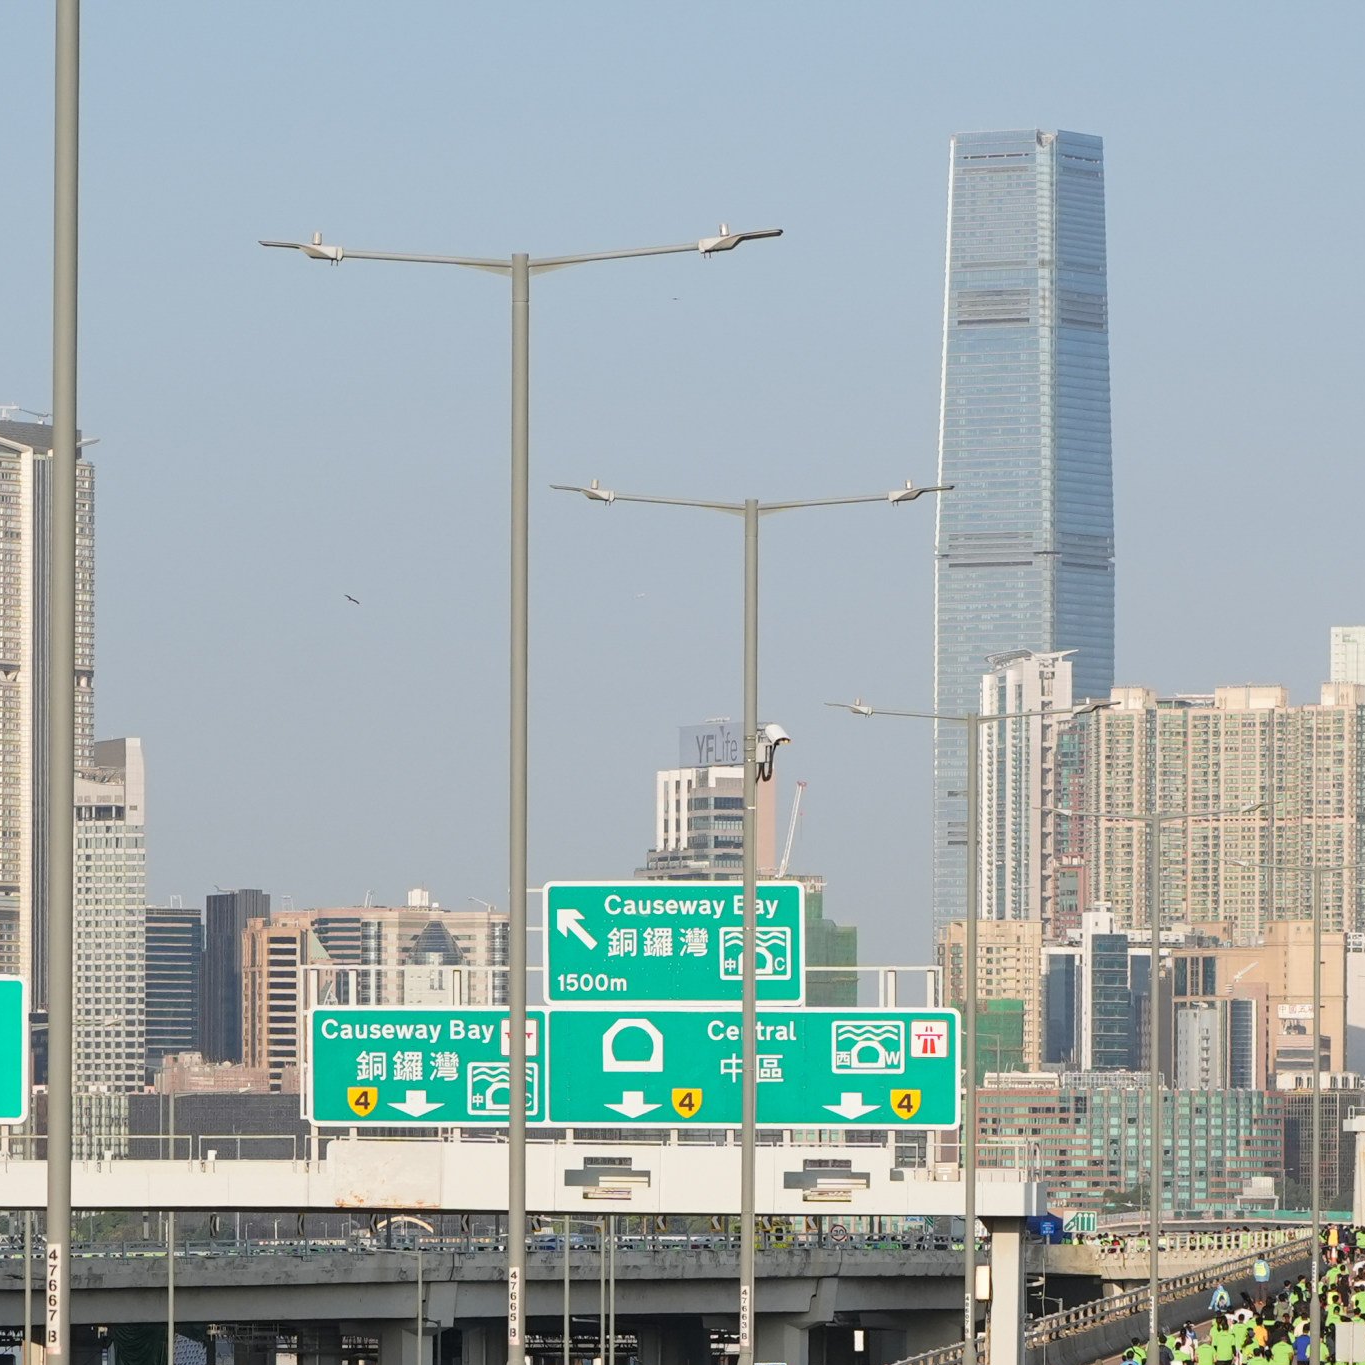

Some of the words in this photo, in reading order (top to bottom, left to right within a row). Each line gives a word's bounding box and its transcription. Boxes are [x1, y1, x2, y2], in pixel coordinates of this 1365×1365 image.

[604, 894, 725, 919] Causeway
[733, 895, 778, 919] Bay
[607, 927, 709, 957] 銅鑼灣
[724, 958, 736, 973] 中
[774, 957, 785, 971] C
[557, 973, 627, 992] 1500m
[321, 1018, 441, 1043] Causeway
[449, 1019, 495, 1043] Bay
[707, 1019, 797, 1042] Cetral
[356, 1050, 459, 1082] 銅鑼灣
[720, 1053, 784, 1083] 中區
[836, 1051, 850, 1067] 西
[884, 1051, 900, 1066] W
[355, 1091, 370, 1110] 4
[472, 1093, 484, 1107] 中
[679, 1092, 695, 1111] 4
[897, 1094, 913, 1112] 4
